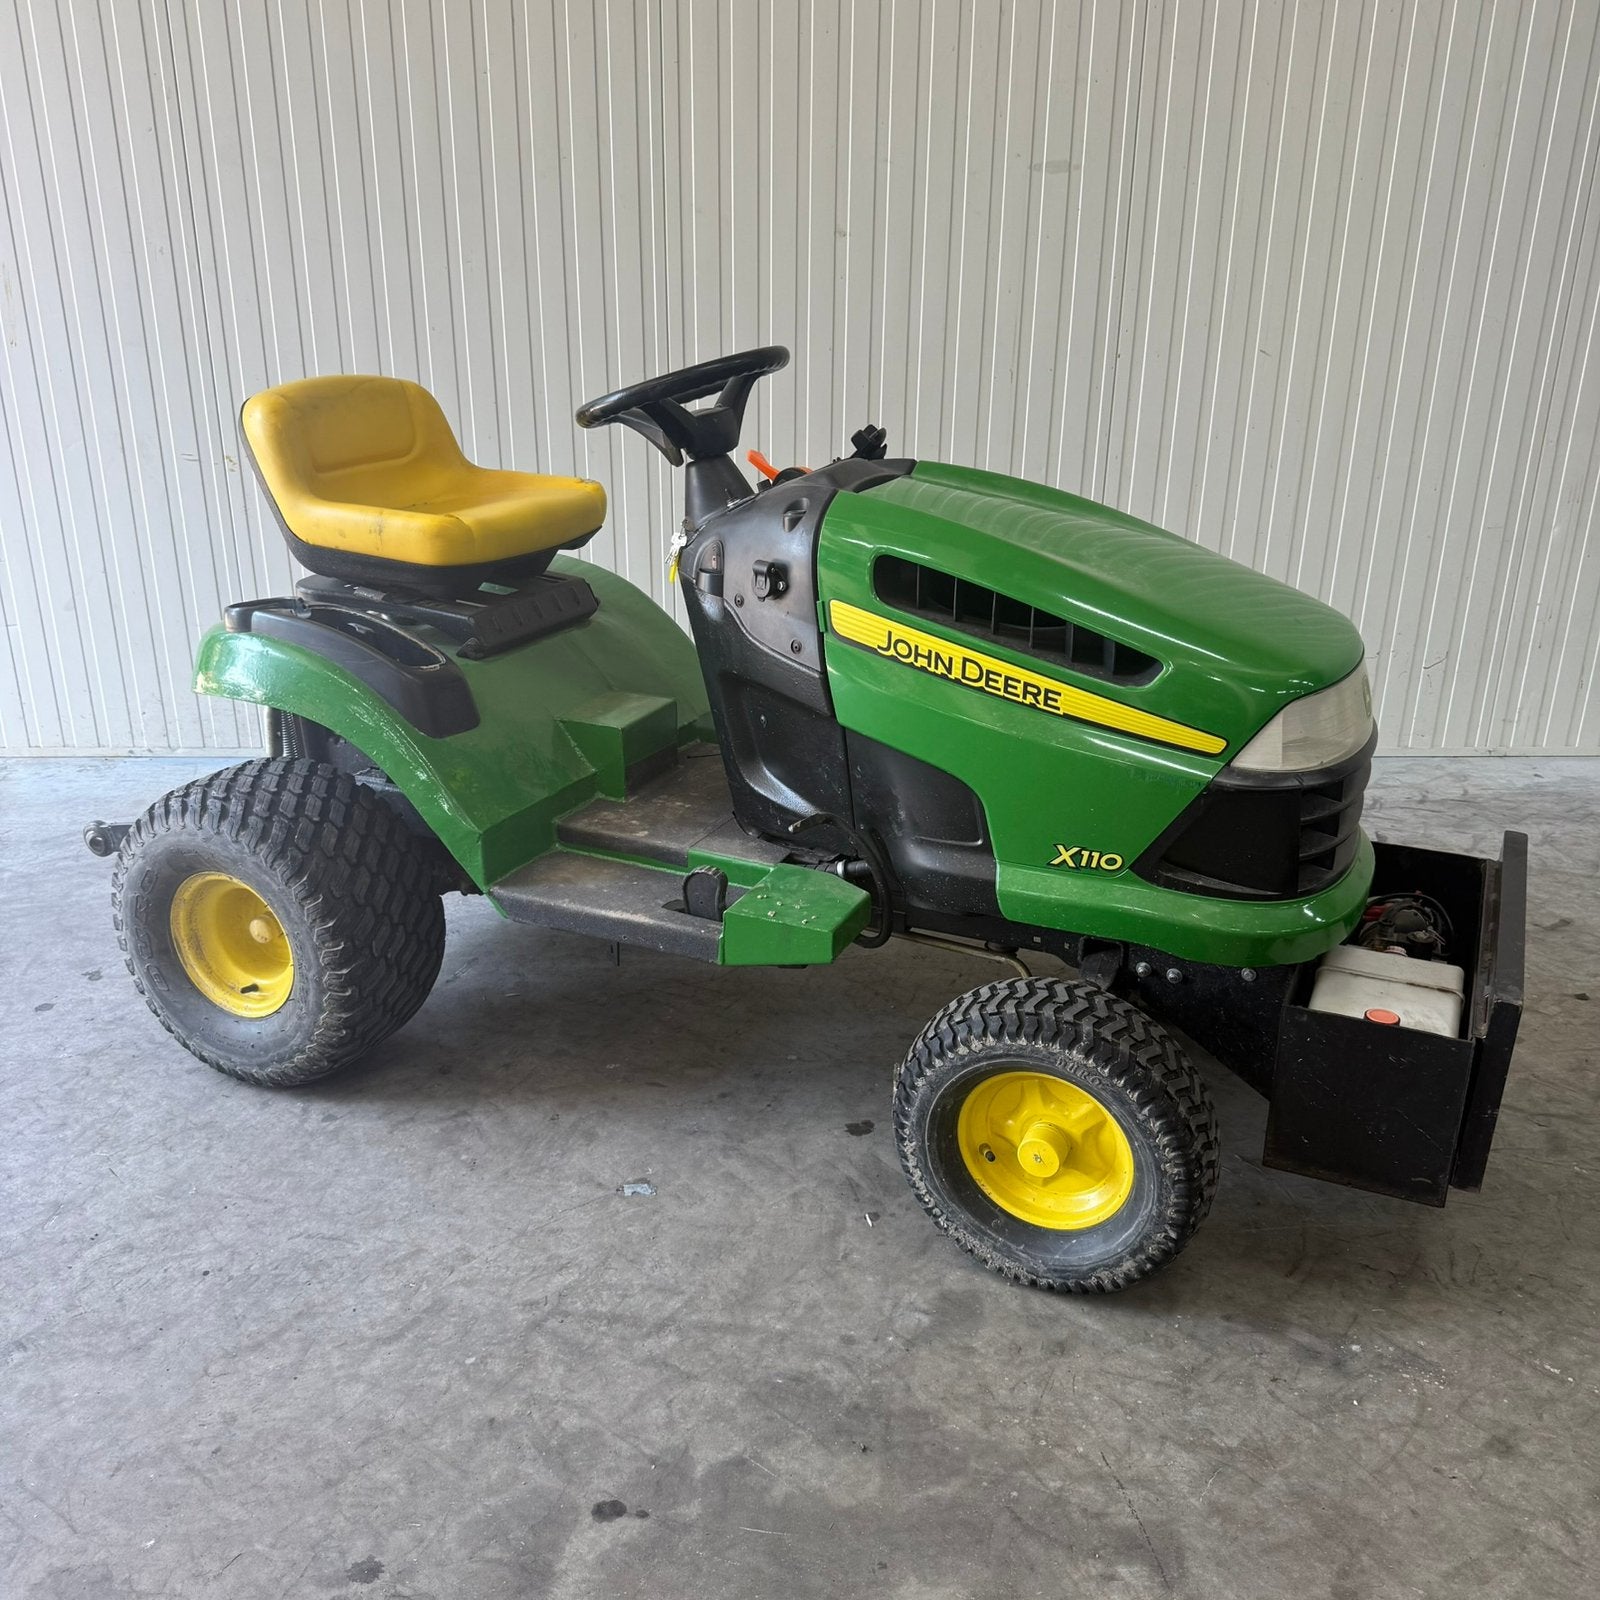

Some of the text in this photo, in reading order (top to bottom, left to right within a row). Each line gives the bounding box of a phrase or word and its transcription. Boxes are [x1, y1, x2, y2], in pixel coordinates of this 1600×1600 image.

[877, 630, 1062, 711] JOHN DEERE
[1048, 843, 1123, 871] X110
